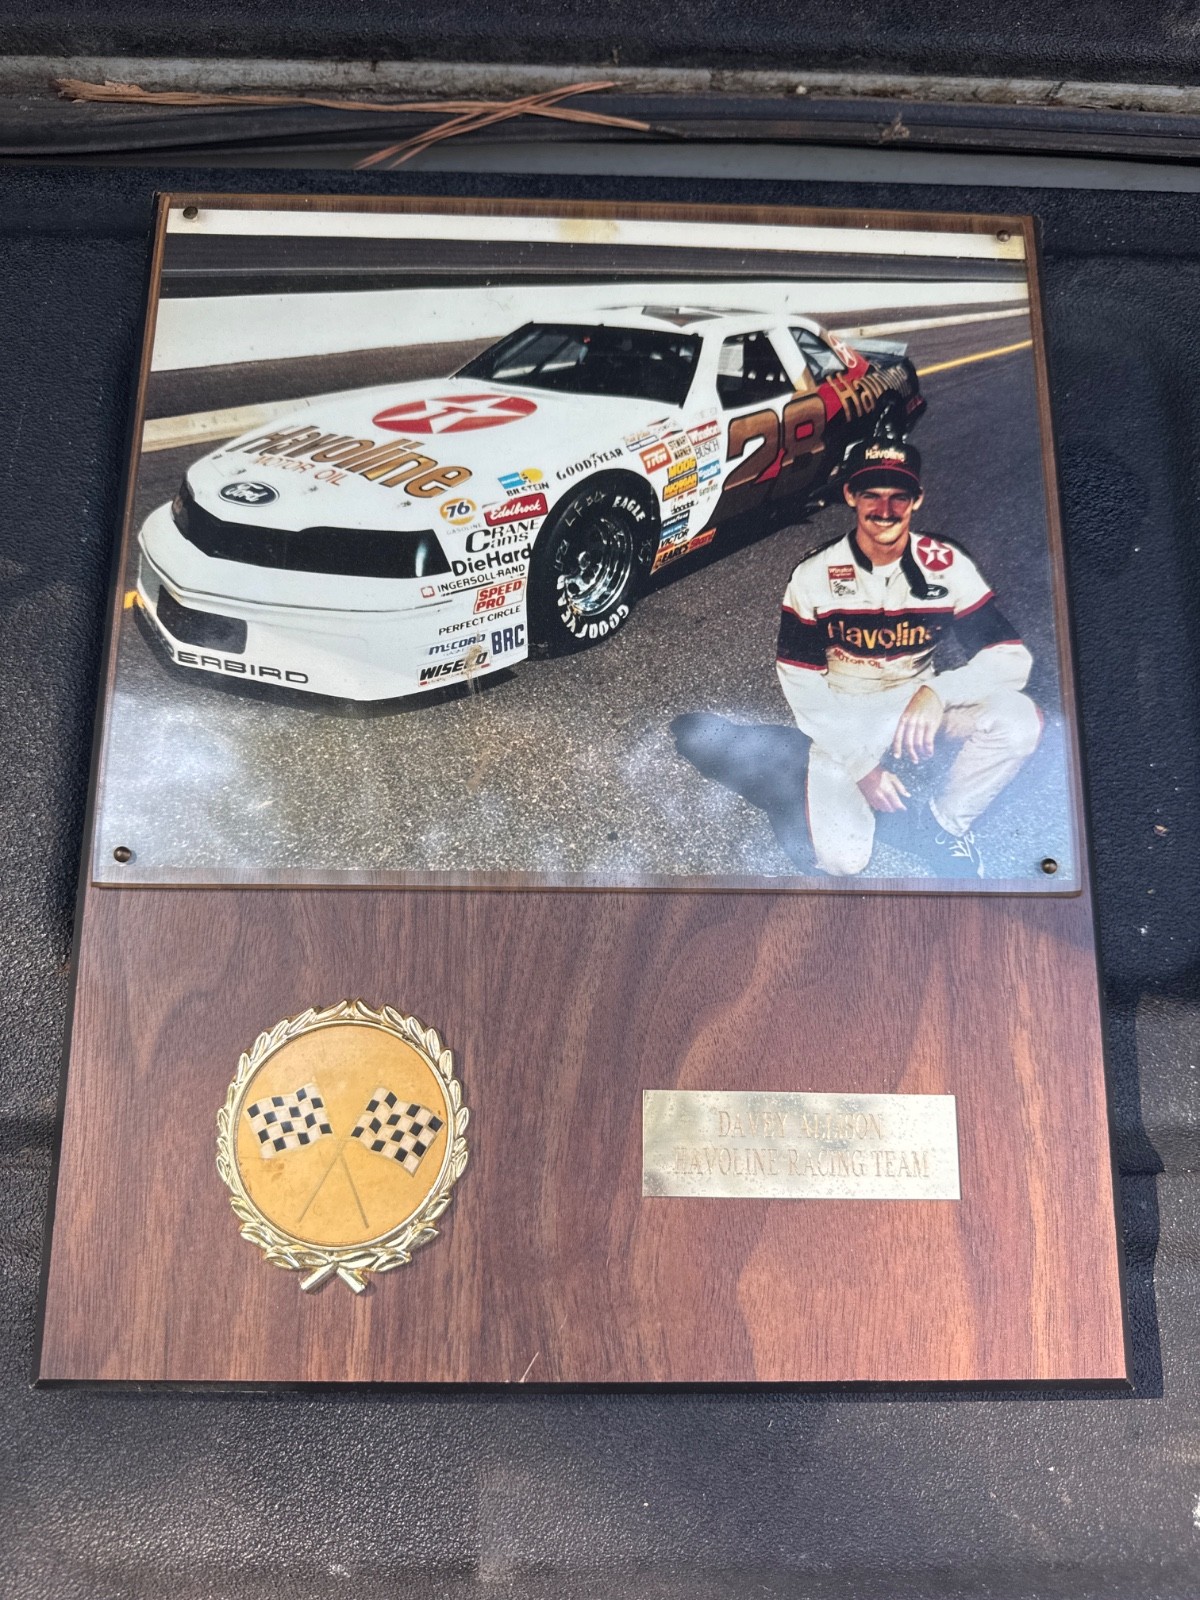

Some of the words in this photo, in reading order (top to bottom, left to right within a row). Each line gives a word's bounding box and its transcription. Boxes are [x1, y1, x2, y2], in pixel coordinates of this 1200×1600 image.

[694, 438, 720, 460] BUSCH
[225, 425, 471, 498] Havoline
[314, 469, 348, 487] OIL
[505, 482, 550, 497] BILSTEIN
[446, 501, 471, 519] 76
[490, 499, 542, 521] Edelbrock
[611, 495, 646, 523] EAGLE
[451, 543, 531, 577] DieHard
[478, 580, 523, 601] SPEED
[474, 595, 506, 613] PRO
[438, 616, 486, 636] PERFECT
[486, 605, 521, 623] CIRCLE
[490, 623, 525, 656] BRC
[868, 658, 885, 669] OIL
[717, 1109, 788, 1139] DAVEY
[798, 1110, 884, 1140] ALLISON
[673, 1146, 779, 1176] HAVOLINE
[787, 1147, 865, 1178] RACING
[870, 1149, 931, 1179] TEAM
